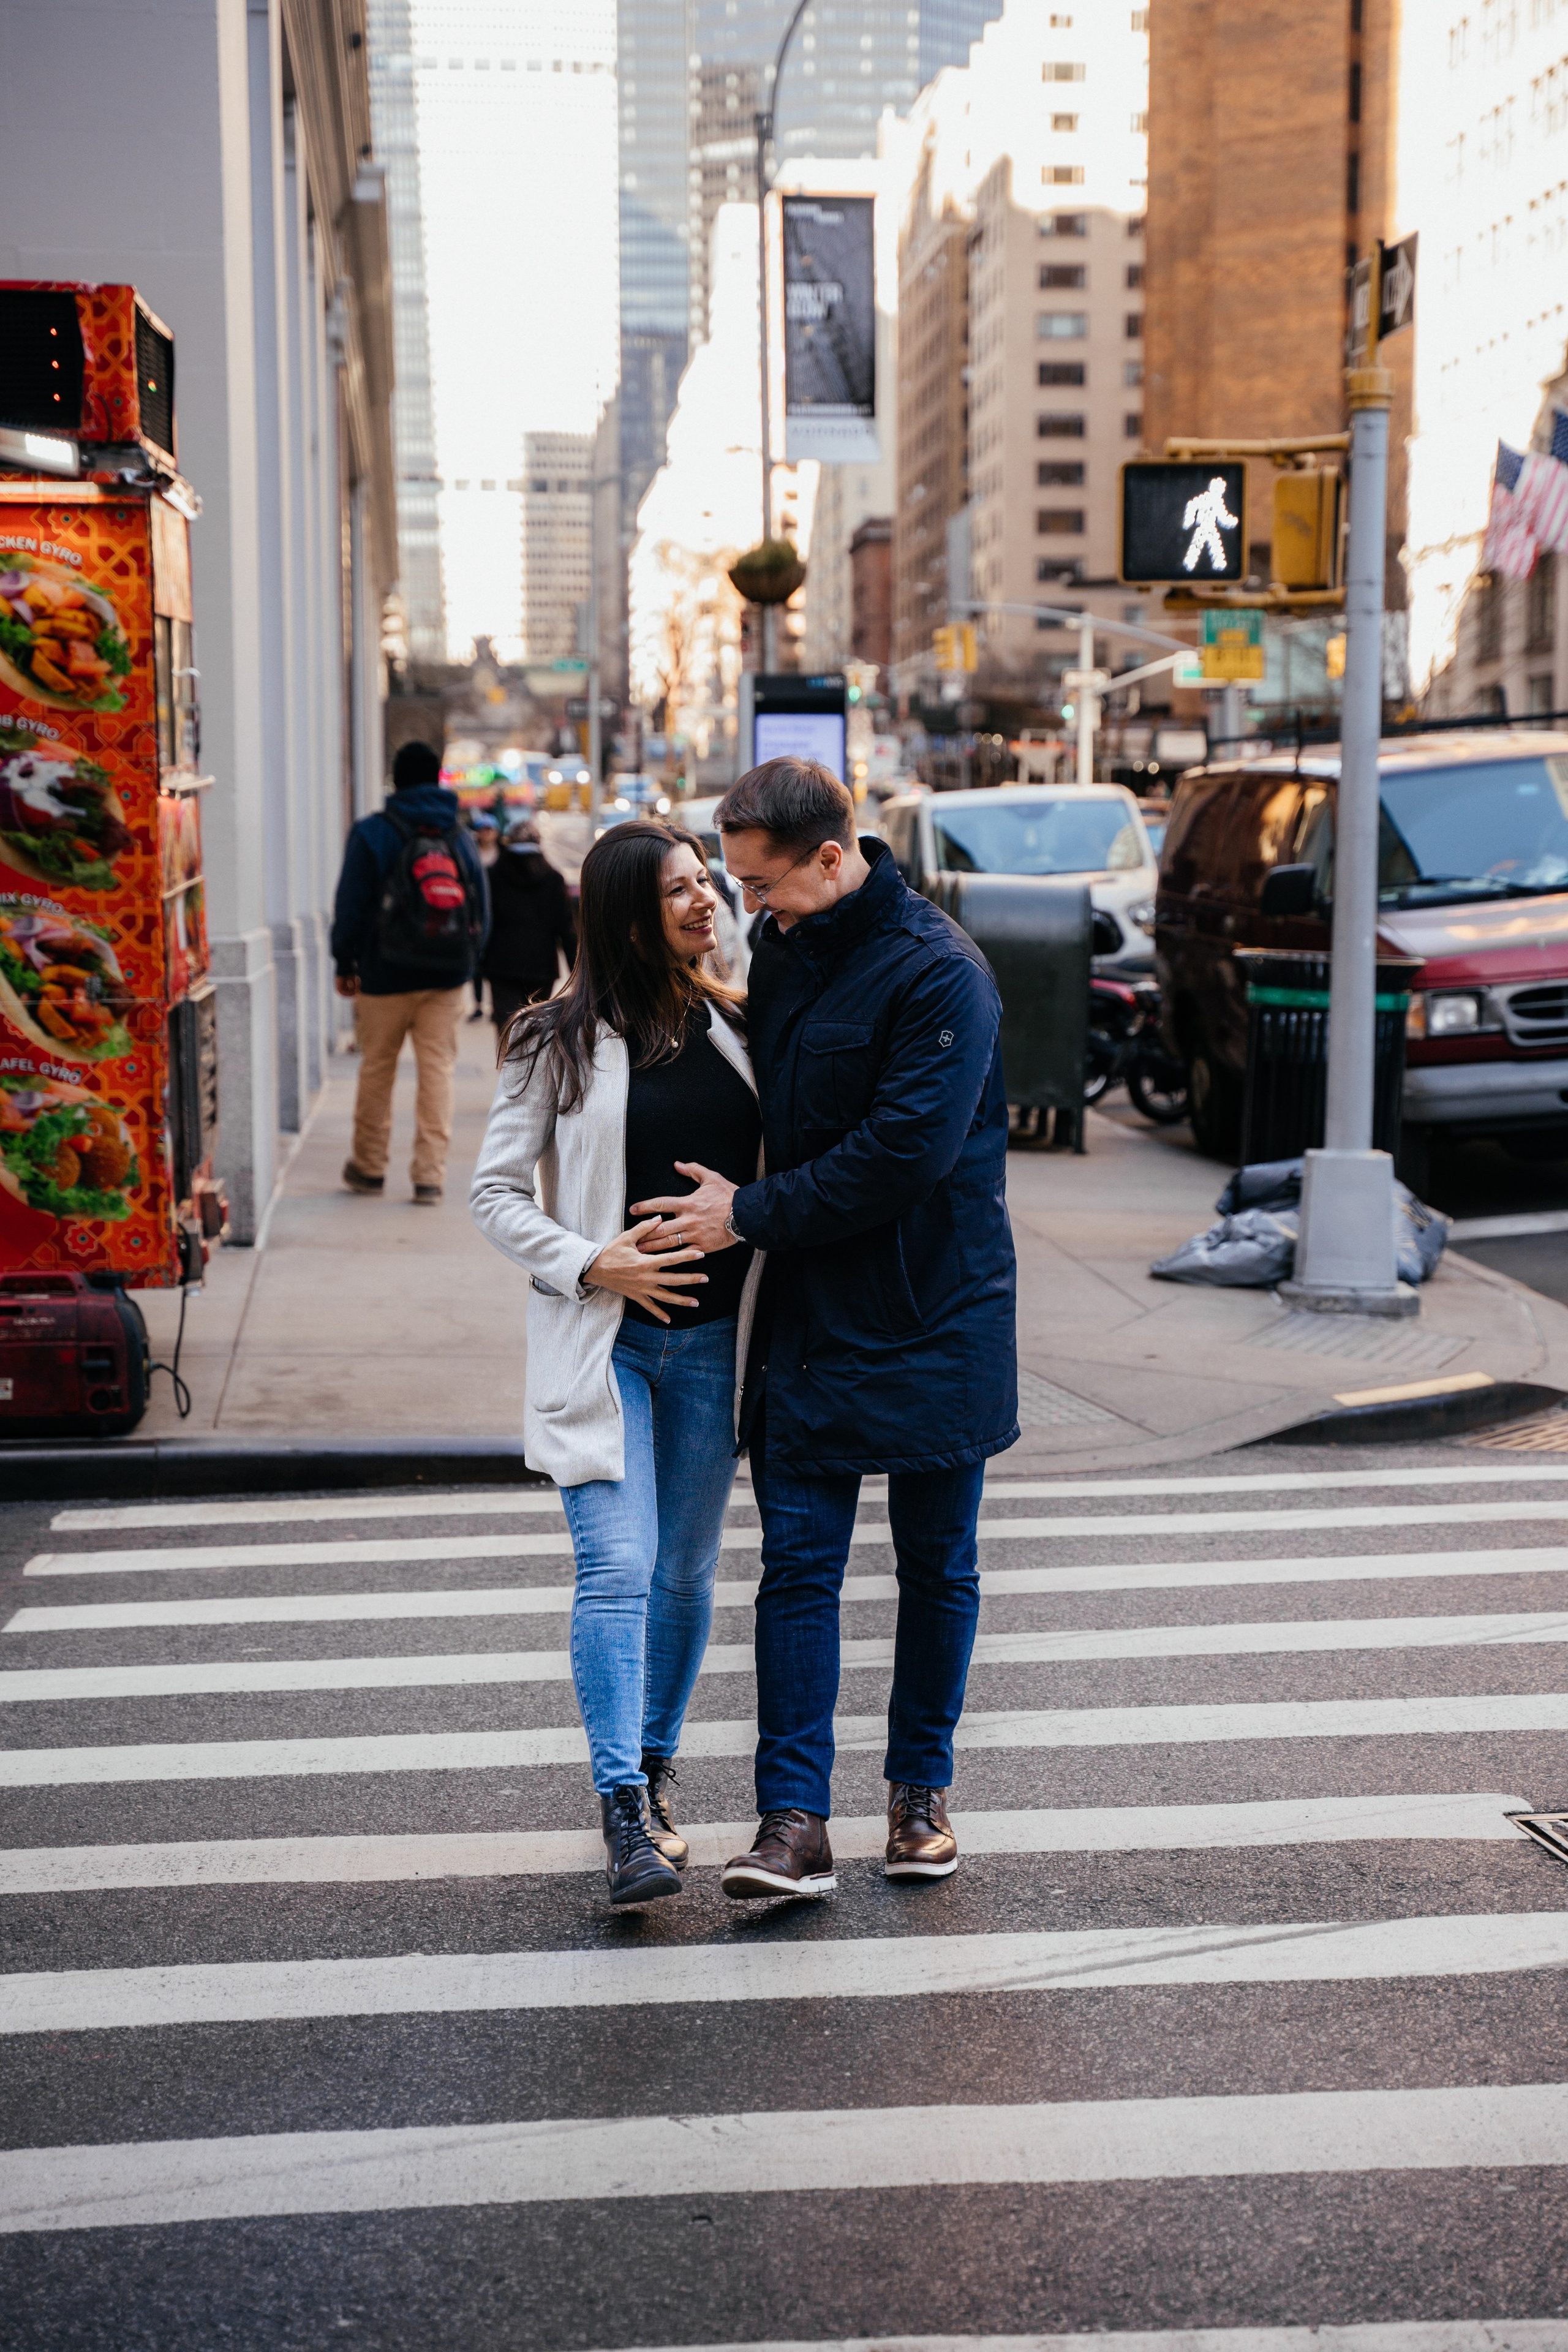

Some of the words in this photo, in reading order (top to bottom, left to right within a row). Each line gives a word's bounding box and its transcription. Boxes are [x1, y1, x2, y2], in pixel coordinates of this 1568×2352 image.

[40, 540, 83, 566] GYRO
[0, 714, 13, 728] B
[16, 716, 59, 741] GYRO
[0, 891, 17, 905] IX
[20, 892, 65, 916] GYRO
[0, 1057, 37, 1072] AFEL
[39, 1061, 81, 1085] GYRO
